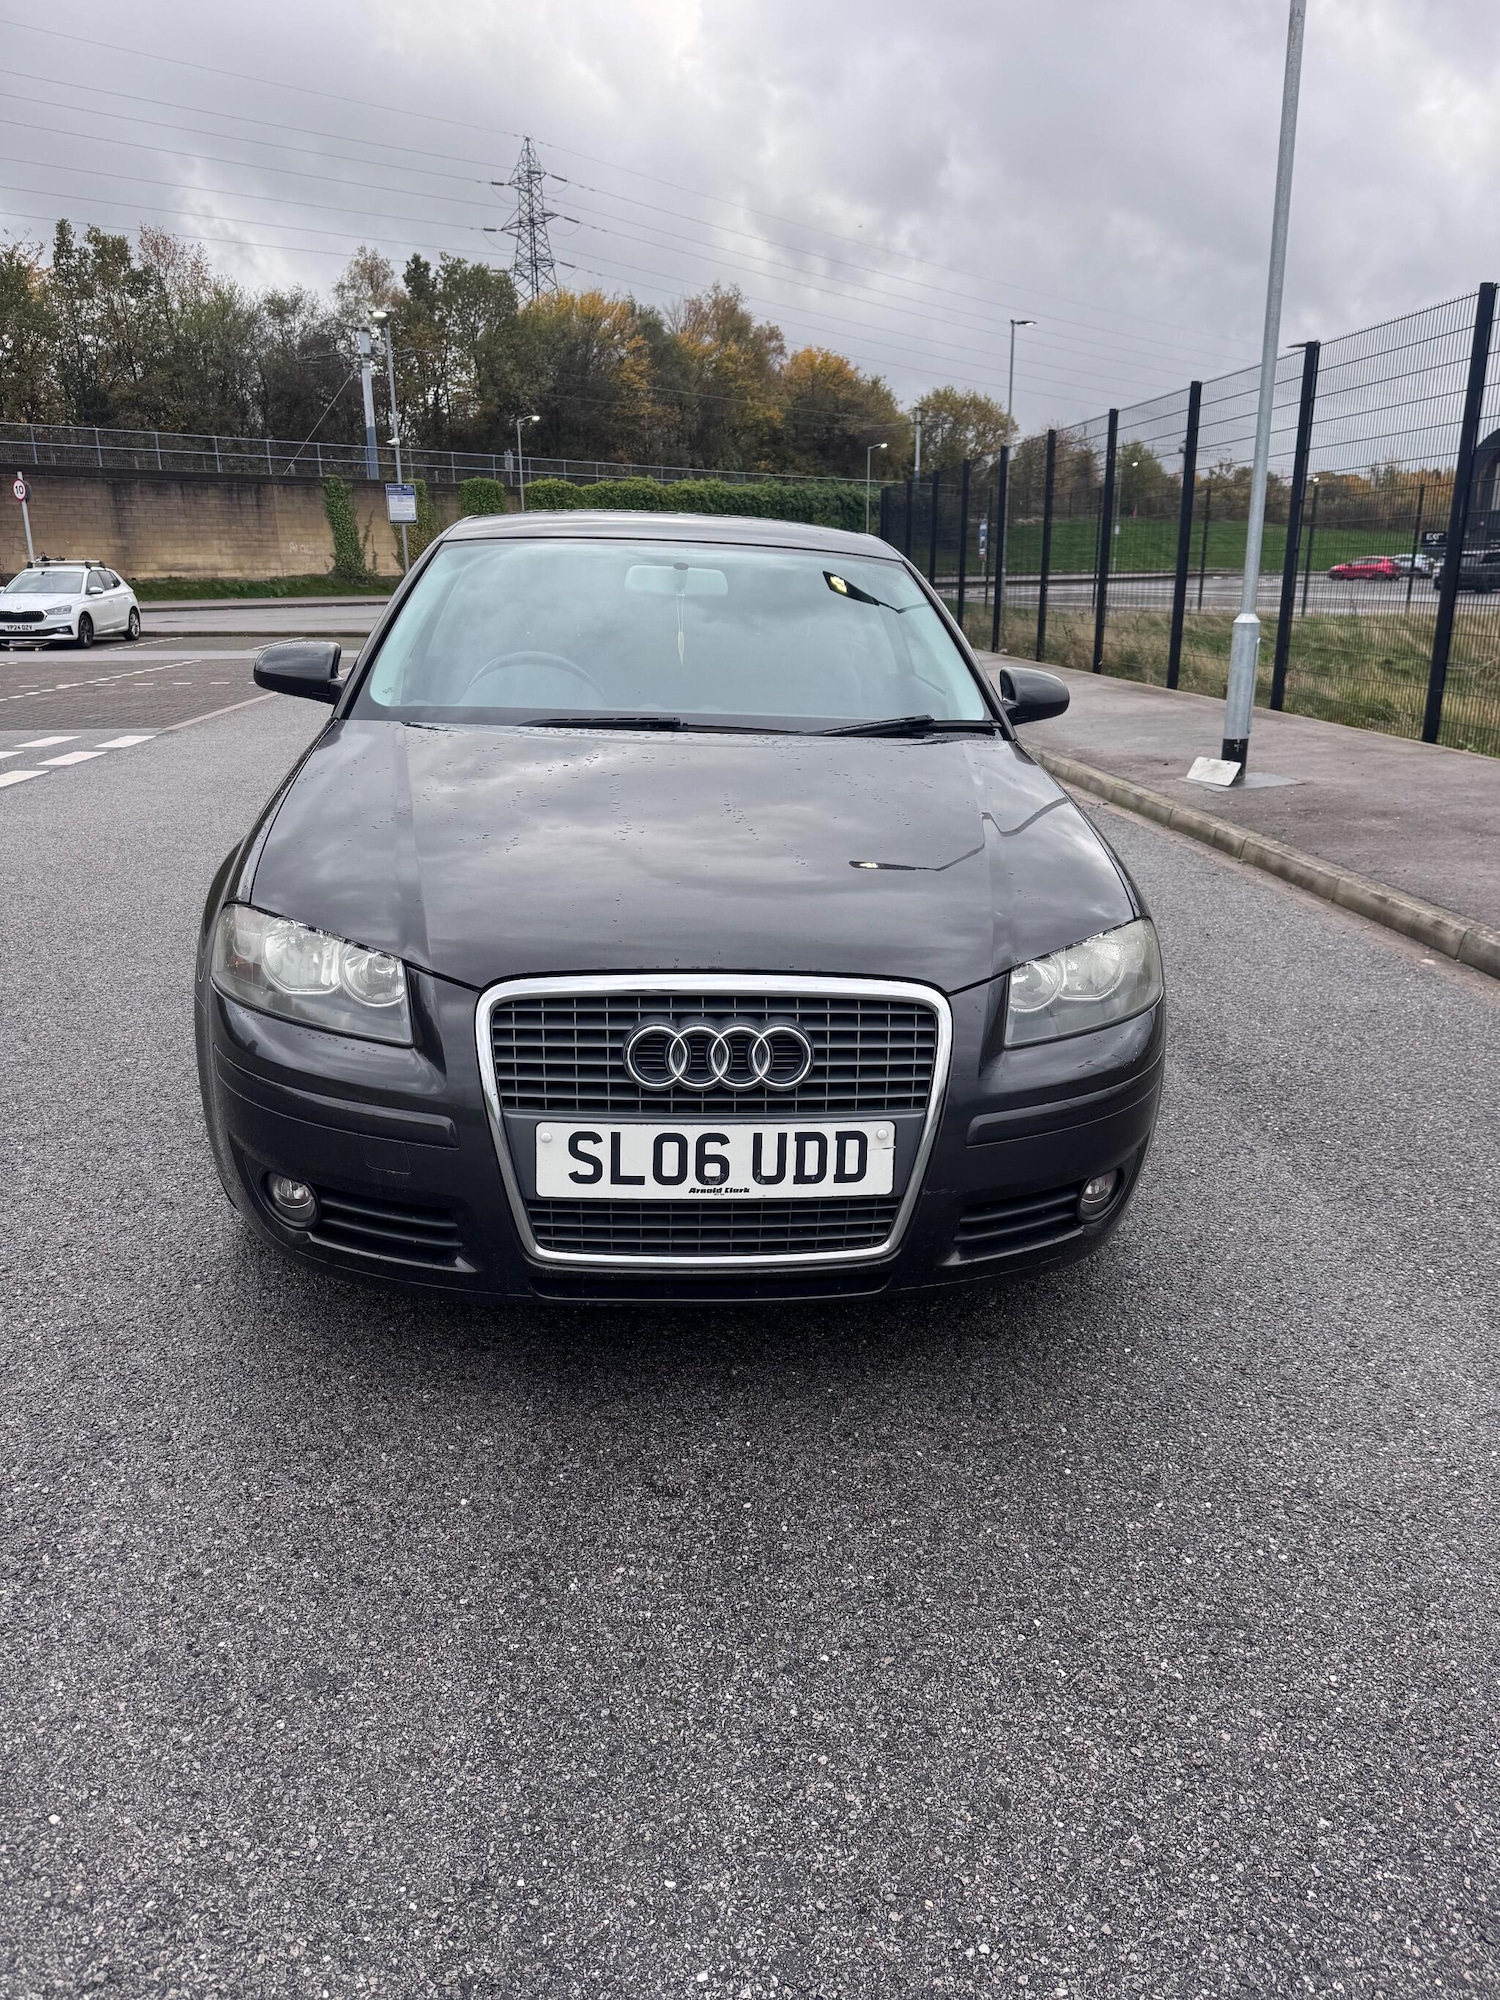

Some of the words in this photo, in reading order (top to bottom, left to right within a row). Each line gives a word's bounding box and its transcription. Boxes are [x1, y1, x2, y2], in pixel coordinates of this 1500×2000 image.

[15, 485, 24, 495] 10
[567, 1130, 731, 1186] SL06
[751, 1130, 869, 1186] UDD
